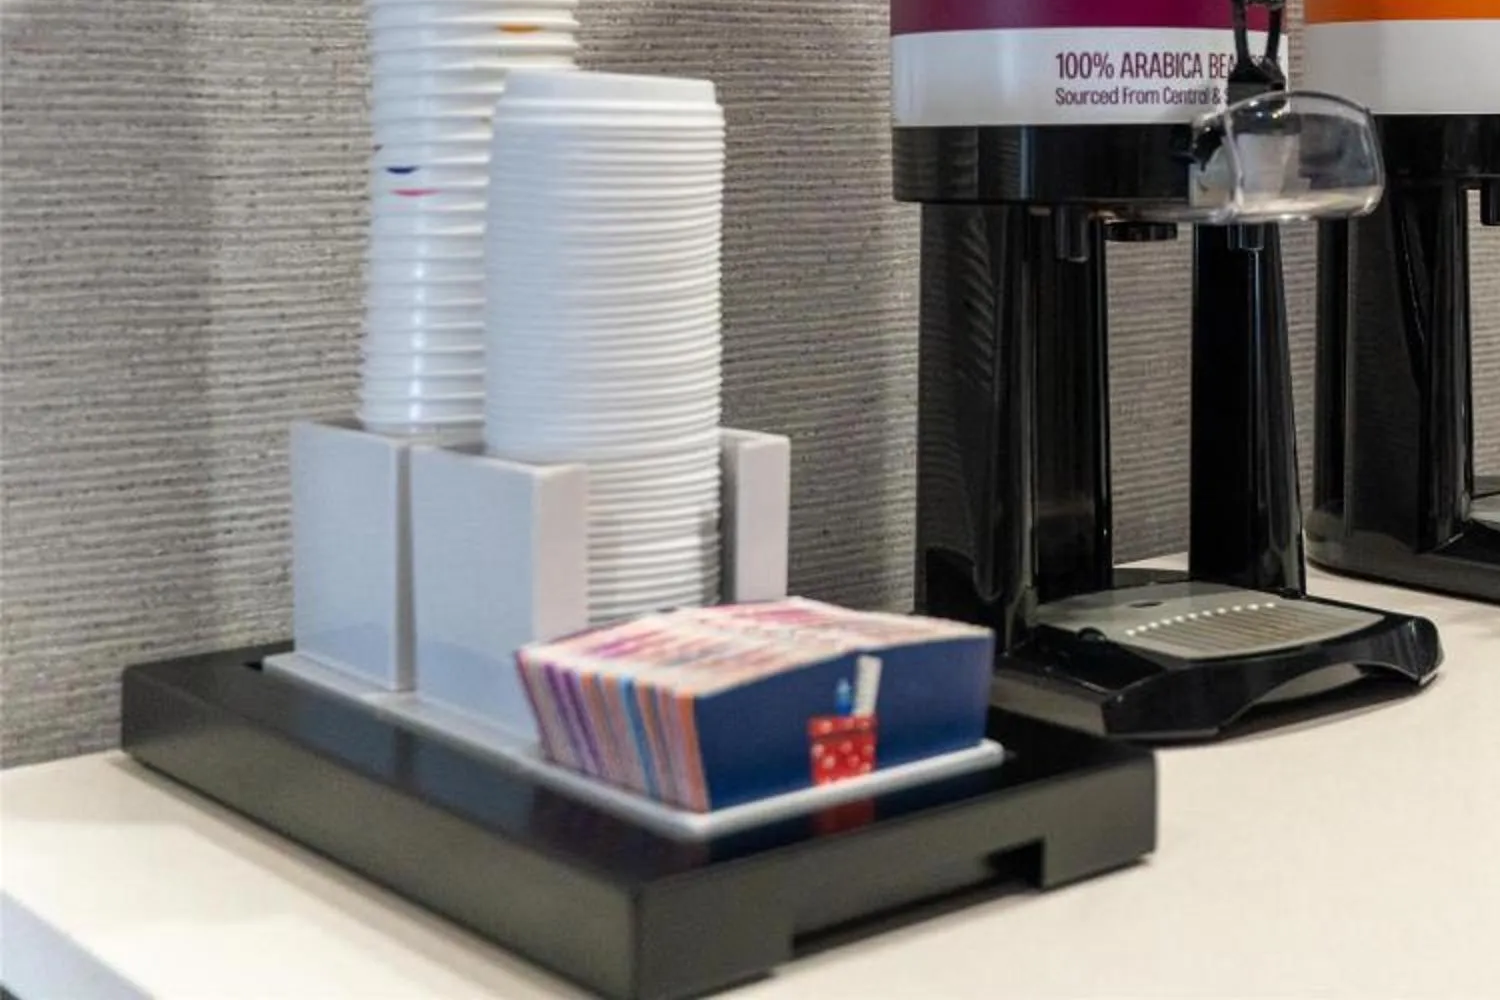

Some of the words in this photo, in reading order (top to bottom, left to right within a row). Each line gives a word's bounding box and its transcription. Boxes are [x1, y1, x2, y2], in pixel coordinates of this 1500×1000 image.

[1056, 52, 1114, 79] 100%
[1120, 52, 1202, 79] ARABICA
[1055, 86, 1118, 105] Sourced
[1122, 87, 1159, 105] From
[1163, 86, 1208, 105] Central
[1211, 87, 1221, 105] &
